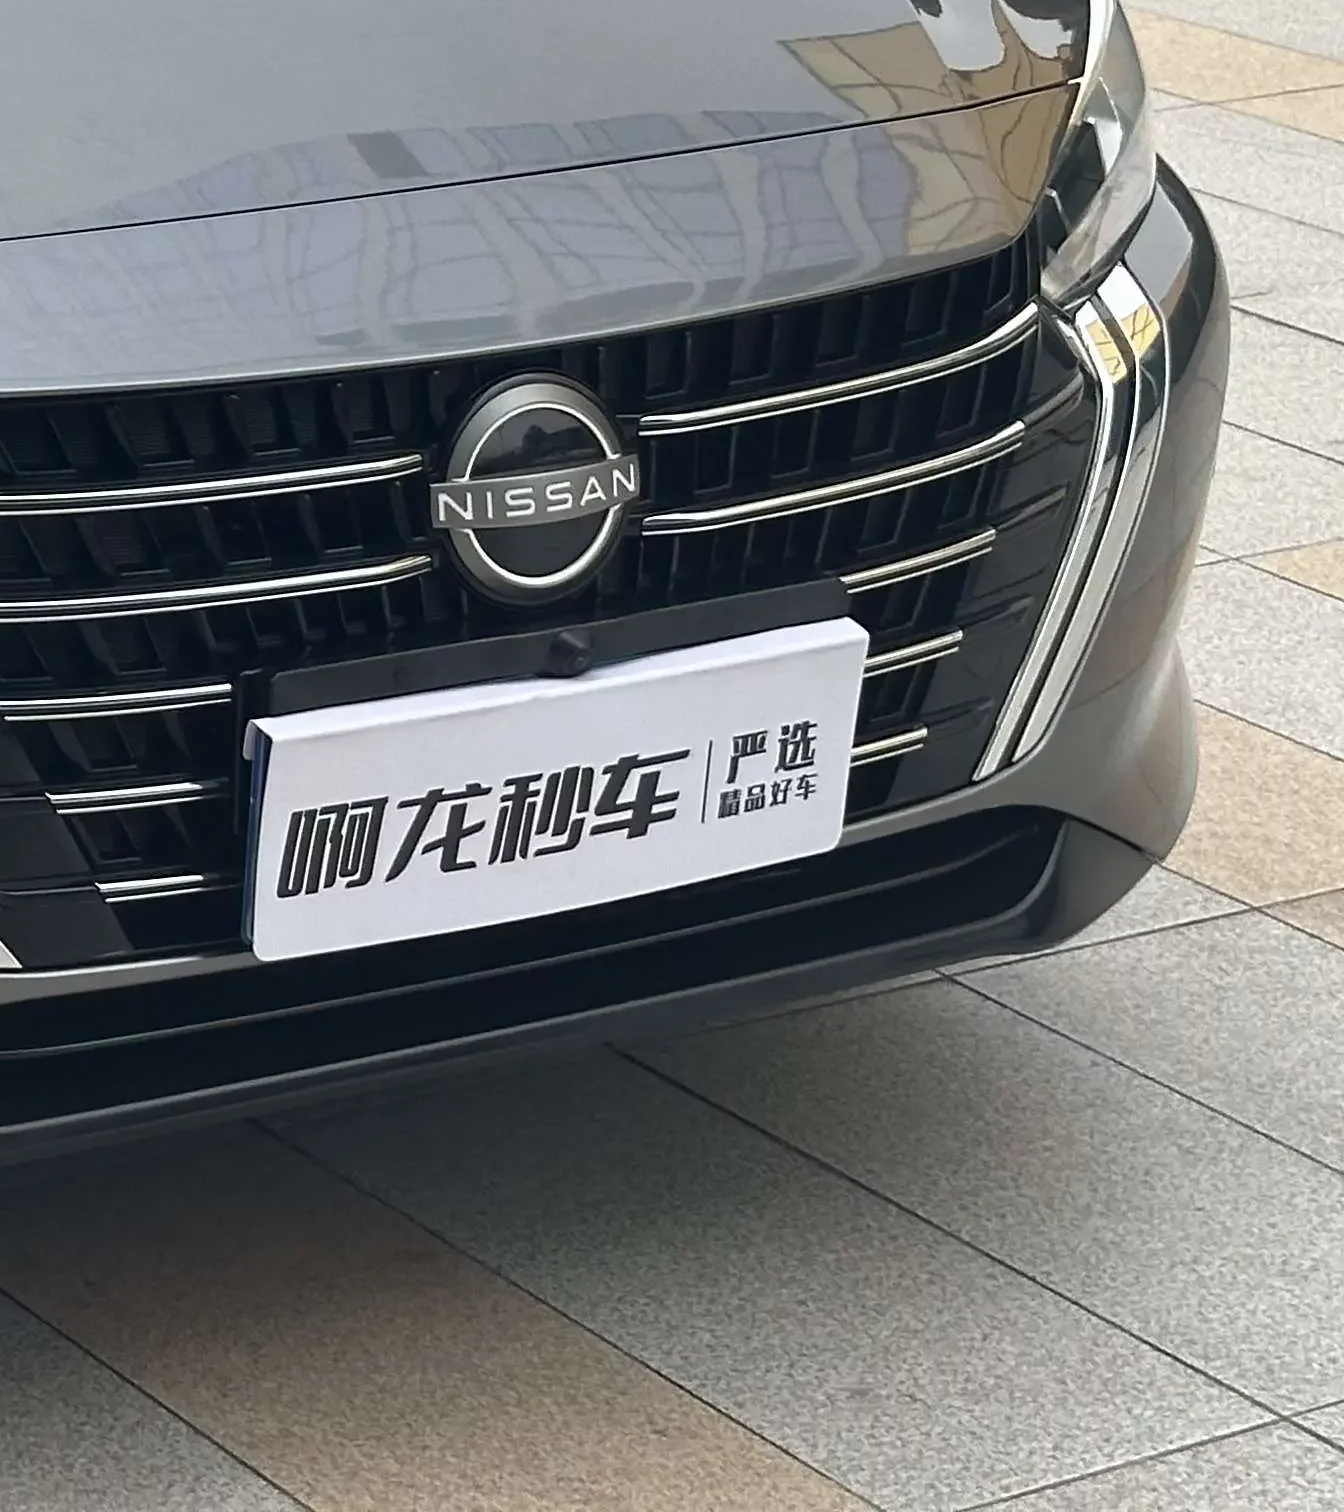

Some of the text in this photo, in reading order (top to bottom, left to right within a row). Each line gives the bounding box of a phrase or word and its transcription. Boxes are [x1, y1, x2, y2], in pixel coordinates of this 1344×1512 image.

[437, 464, 635, 522] NISSAN
[726, 720, 818, 785] 严选
[276, 748, 691, 899] 啊龙秒车
[717, 773, 819, 819] 精品好车
